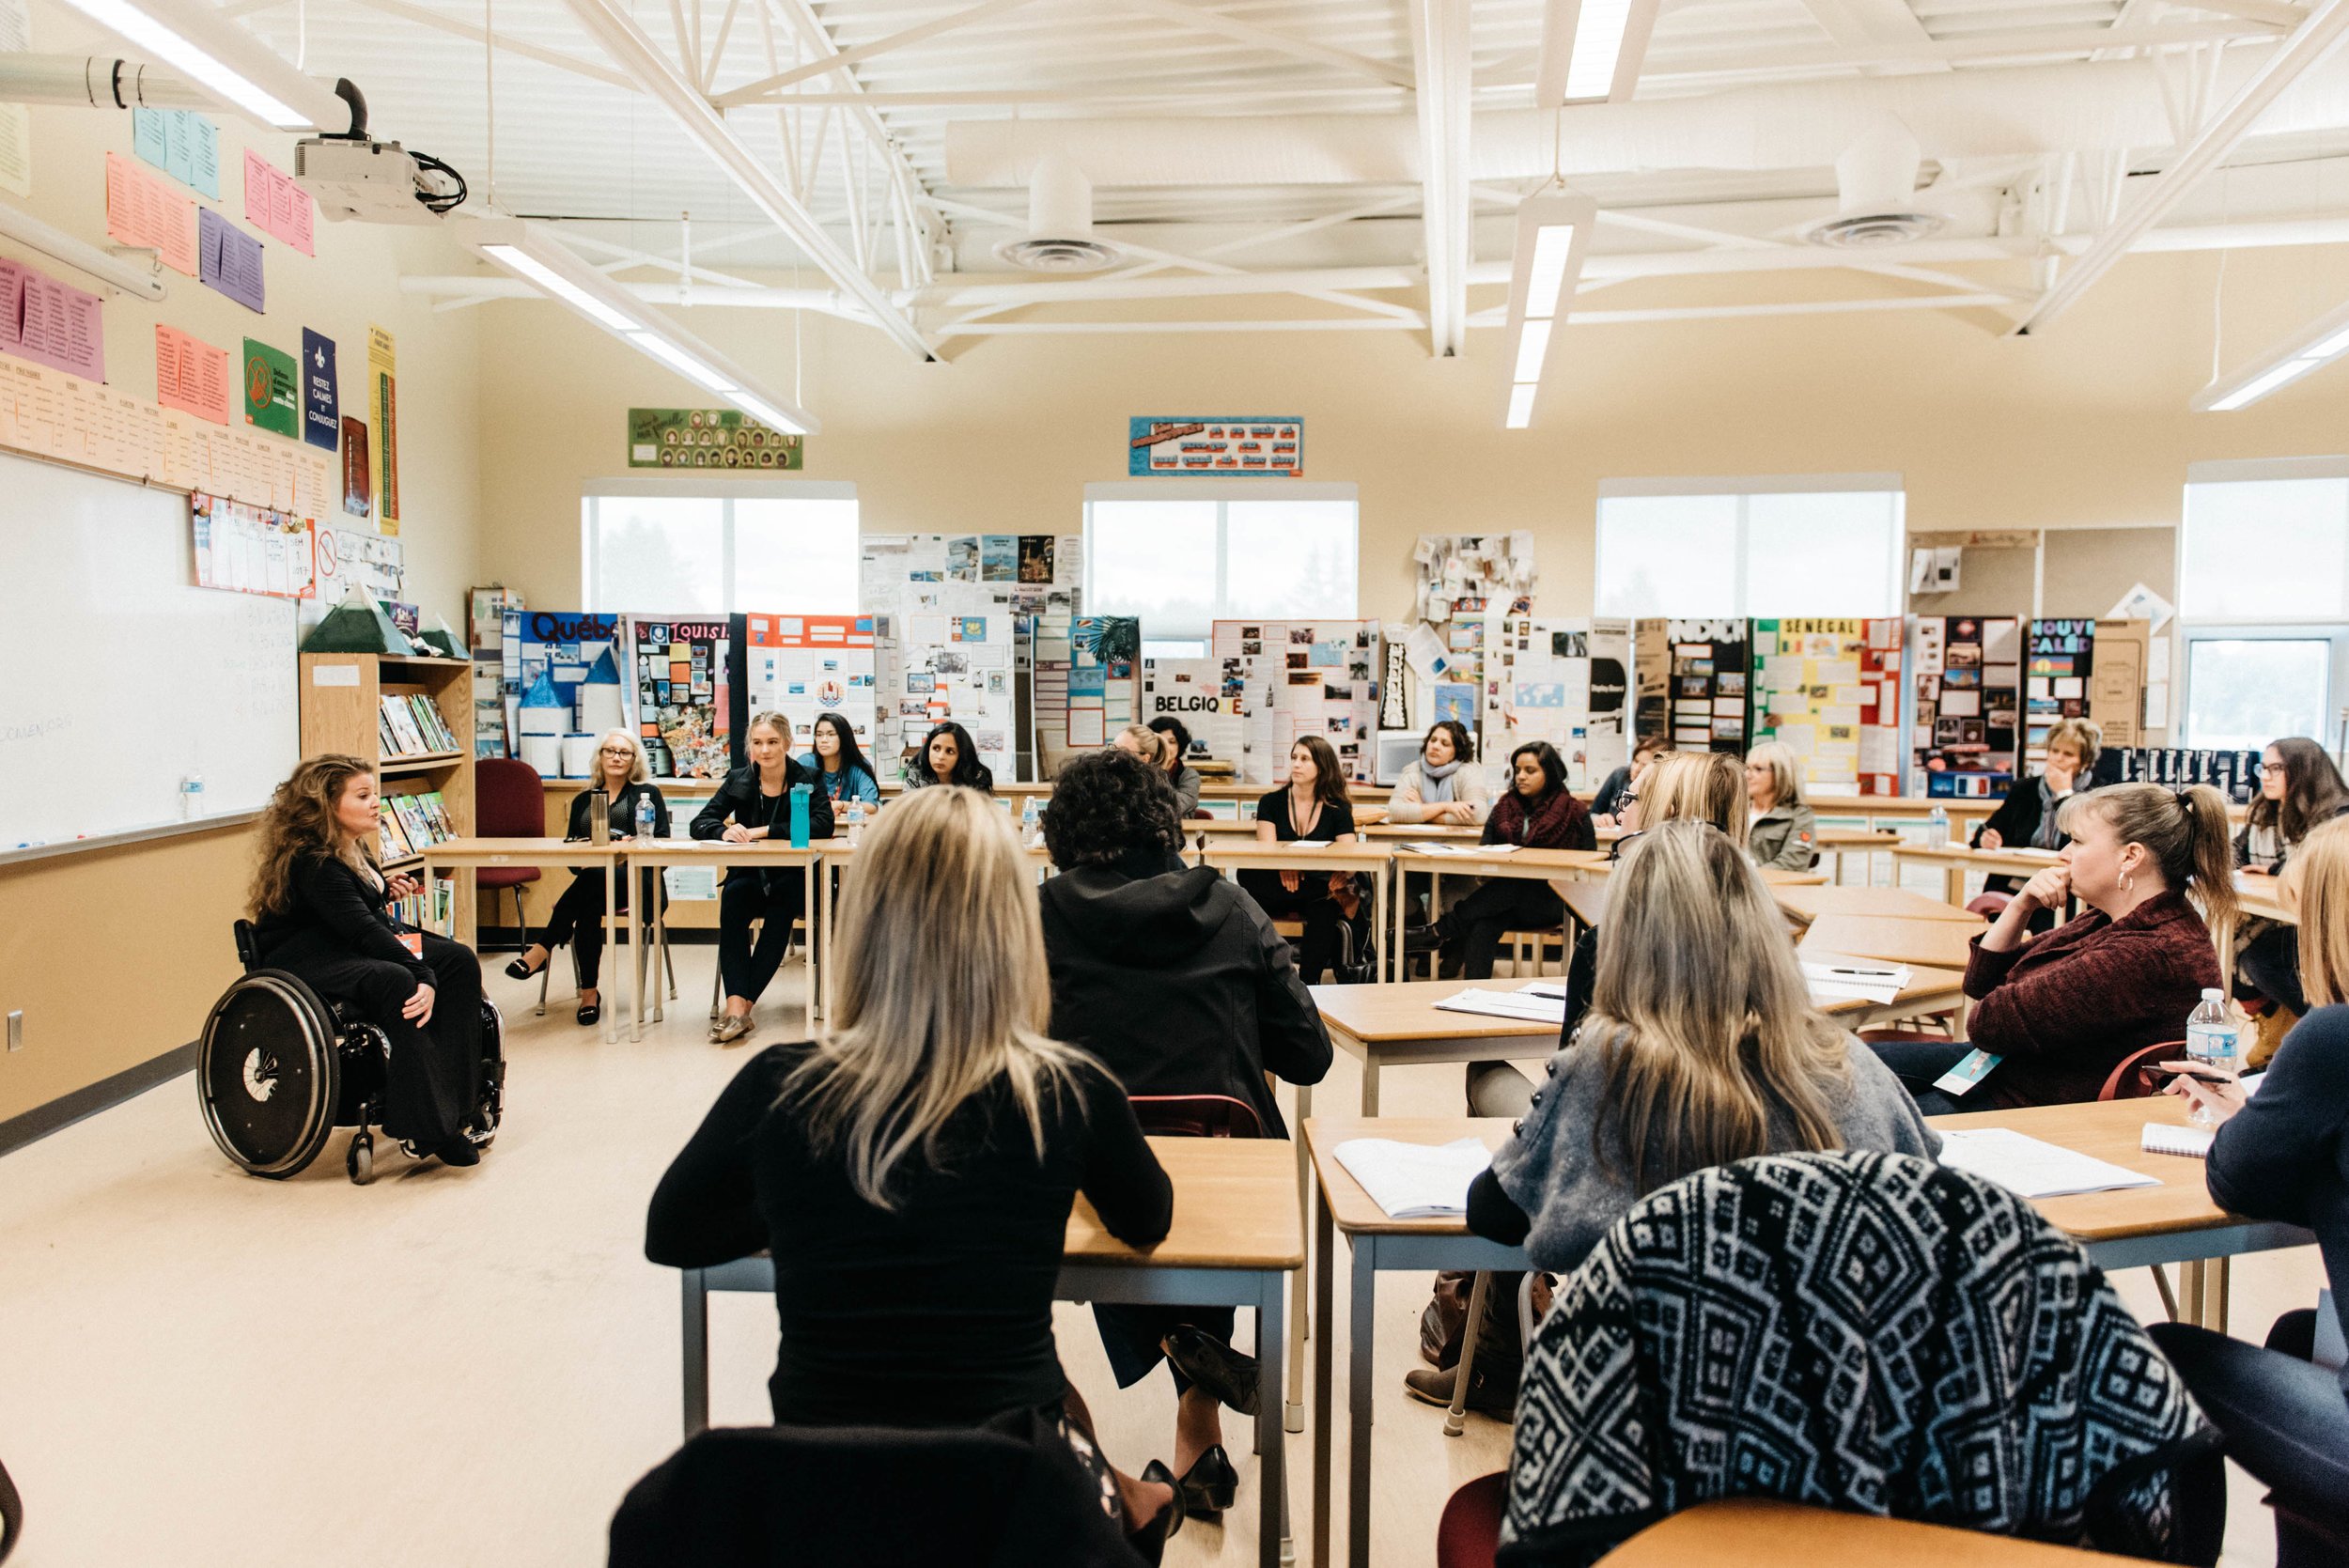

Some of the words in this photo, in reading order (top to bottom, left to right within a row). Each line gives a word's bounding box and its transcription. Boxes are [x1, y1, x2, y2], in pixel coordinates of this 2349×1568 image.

[313, 375, 330, 391] RESTEZ
[313, 388, 332, 405] CALMES
[308, 410, 337, 429] CONJUGUEZ
[1156, 696, 1243, 714] BELGIQUE
